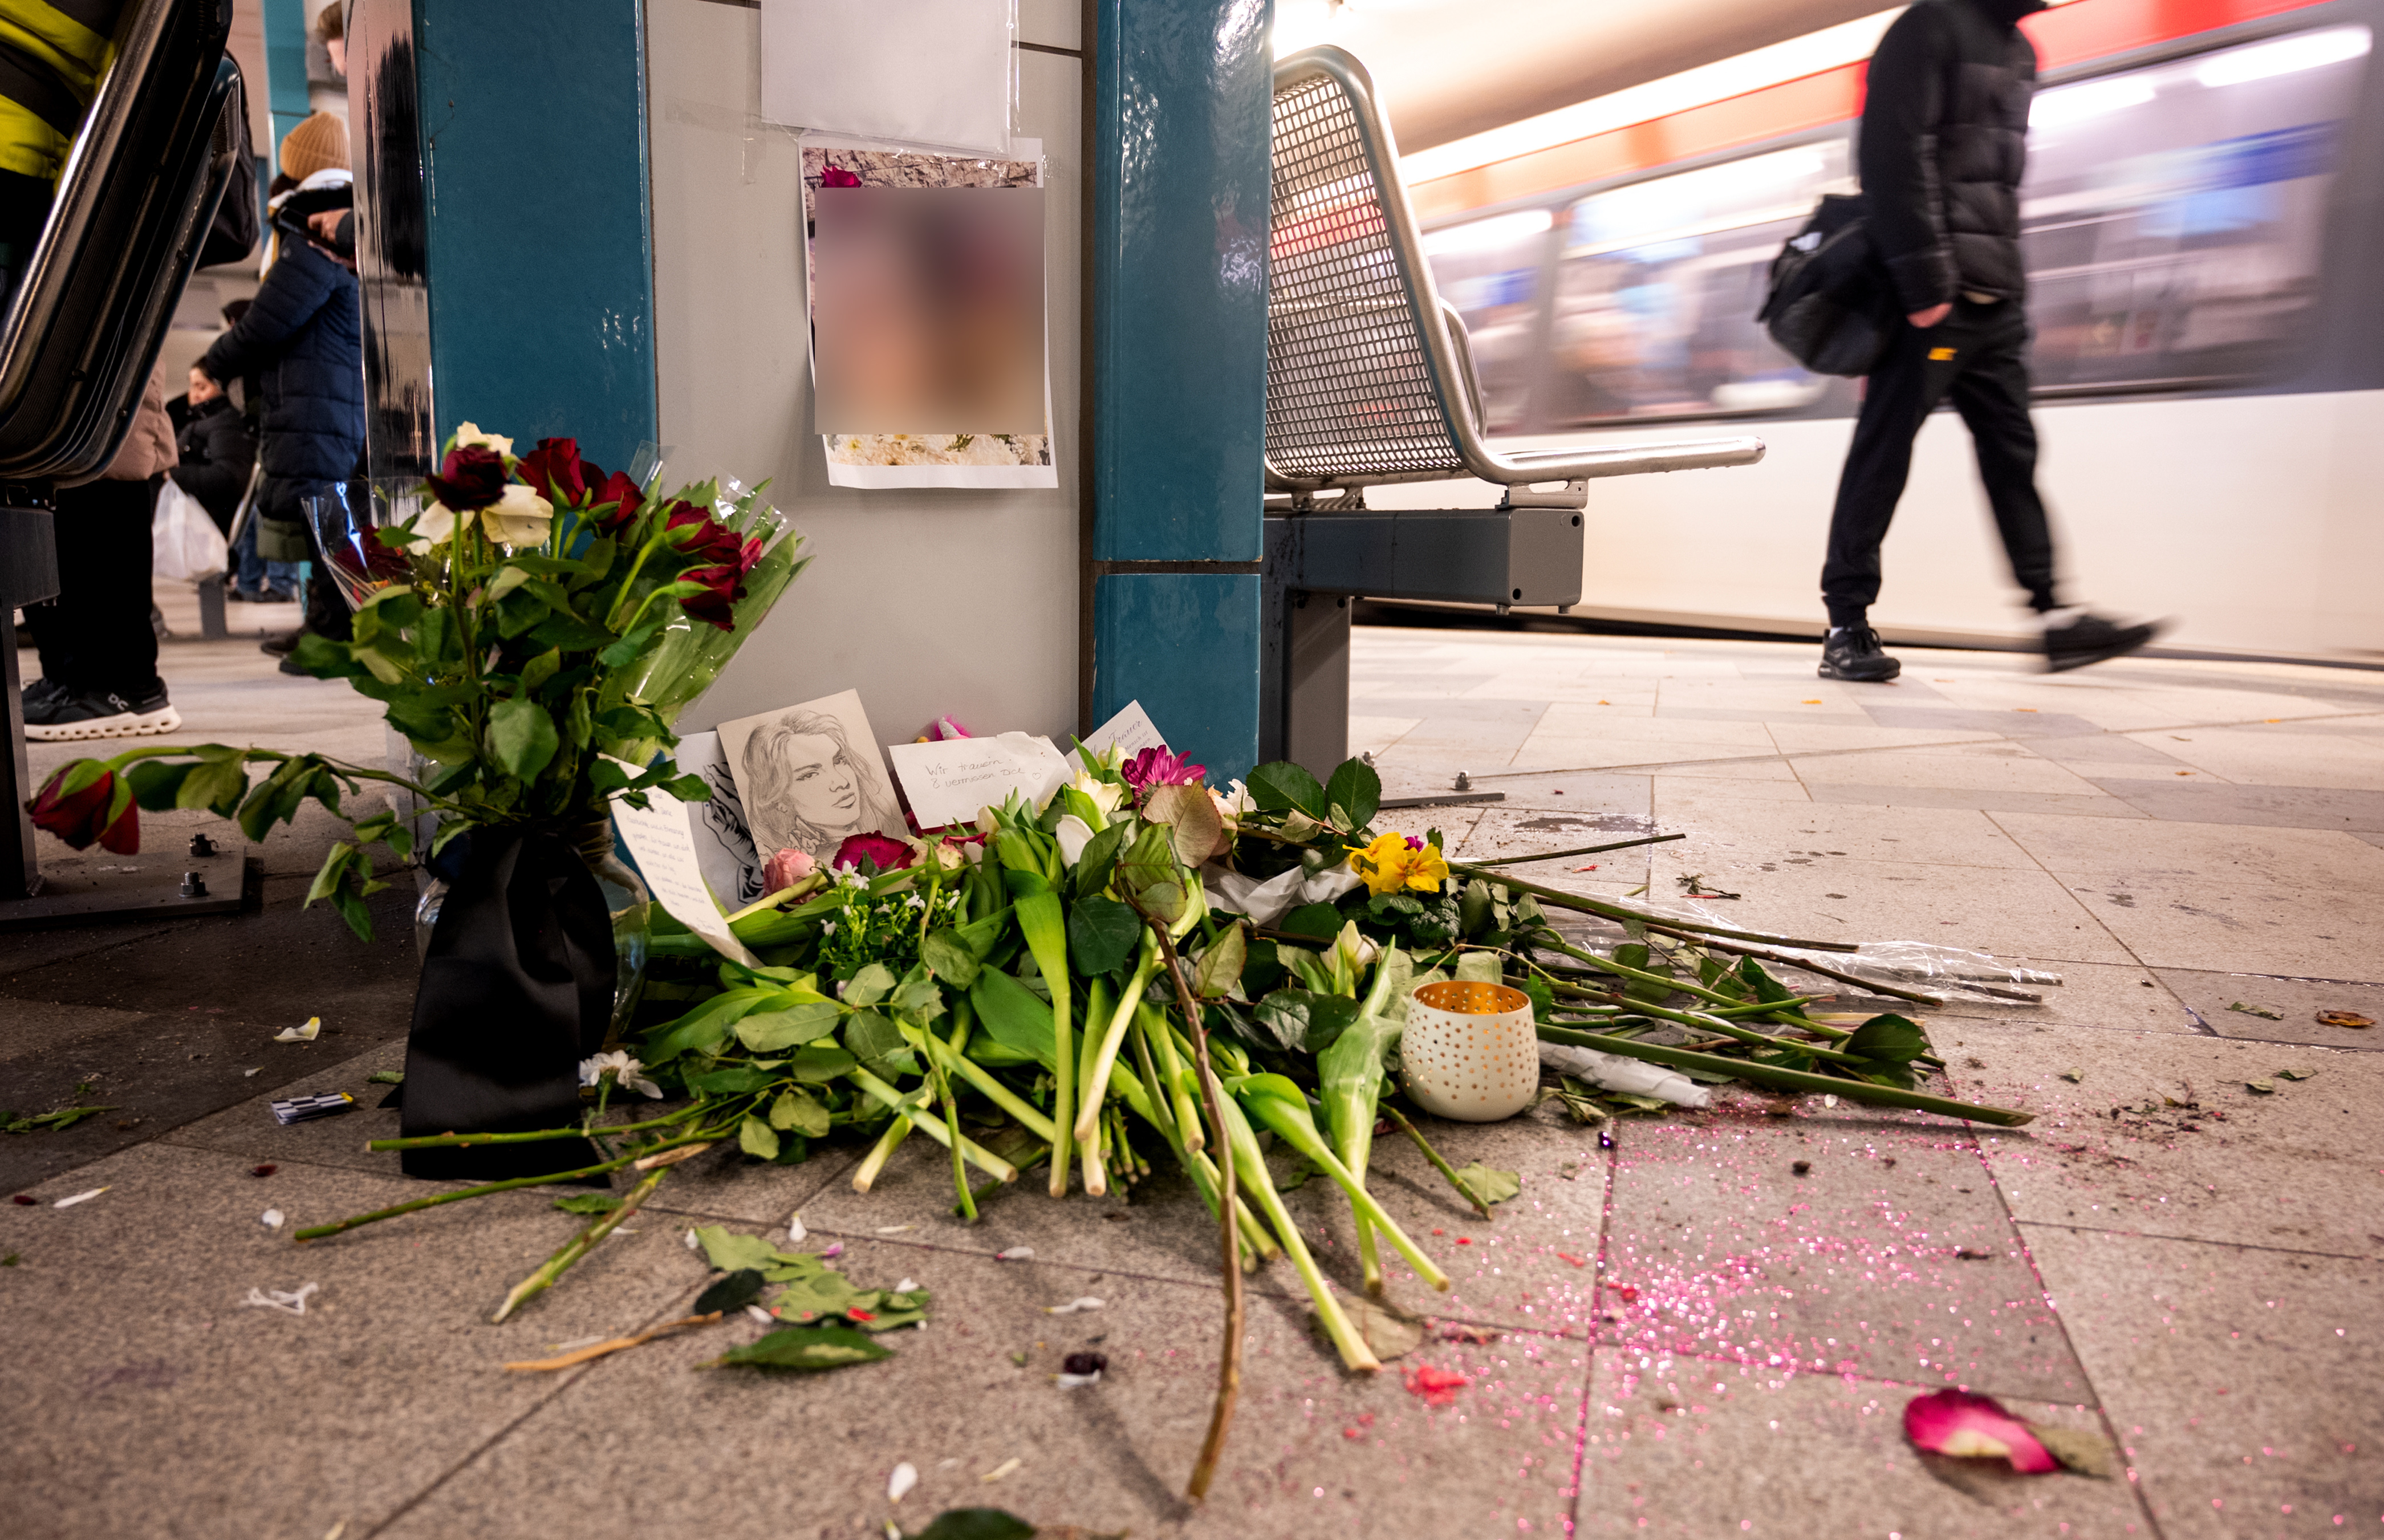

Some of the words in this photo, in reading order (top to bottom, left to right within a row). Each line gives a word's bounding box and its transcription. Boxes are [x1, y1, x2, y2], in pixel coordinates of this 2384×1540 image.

[1108, 720, 1143, 743] Trauer
[1124, 736, 1142, 751] Mensch
[924, 762, 948, 776] Wir
[958, 759, 1004, 772] trauern
[944, 772, 996, 787] vermissen
